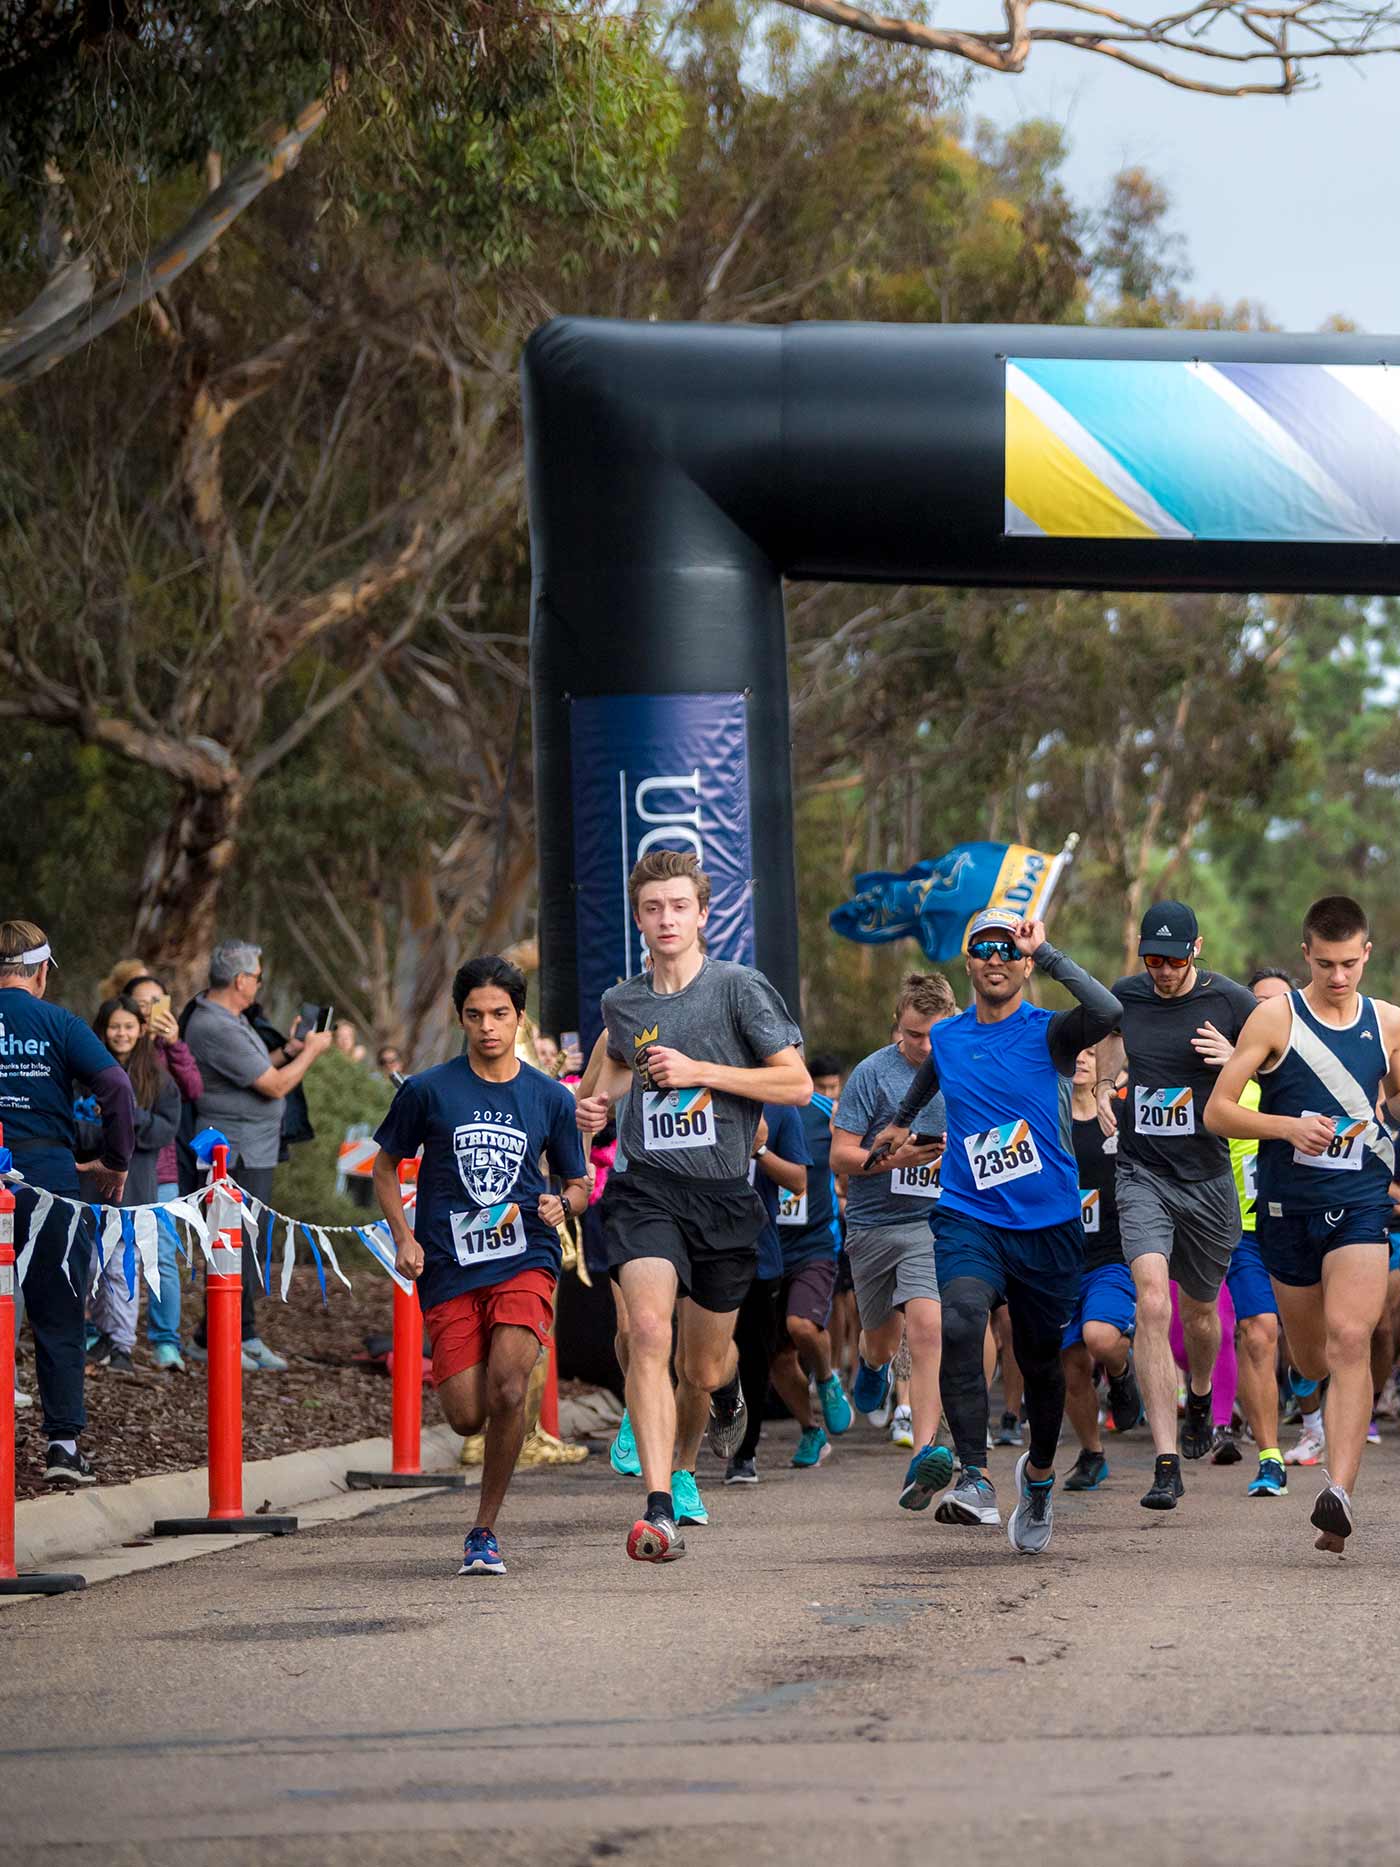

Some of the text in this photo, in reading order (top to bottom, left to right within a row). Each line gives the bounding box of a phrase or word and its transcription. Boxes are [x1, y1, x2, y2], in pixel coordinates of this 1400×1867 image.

[20, 1062, 30, 1070] for
[473, 1110, 513, 1125] 2022
[648, 1109, 708, 1139] 1050
[1140, 1104, 1188, 1127] 2076
[457, 1129, 526, 1154] TRITON
[1327, 1135, 1356, 1159] 87
[475, 1150, 505, 1168] 5K
[974, 1139, 1035, 1180] 2358
[897, 1166, 942, 1190] 1894
[777, 1198, 801, 1217] 37
[461, 1222, 517, 1255] 1759
